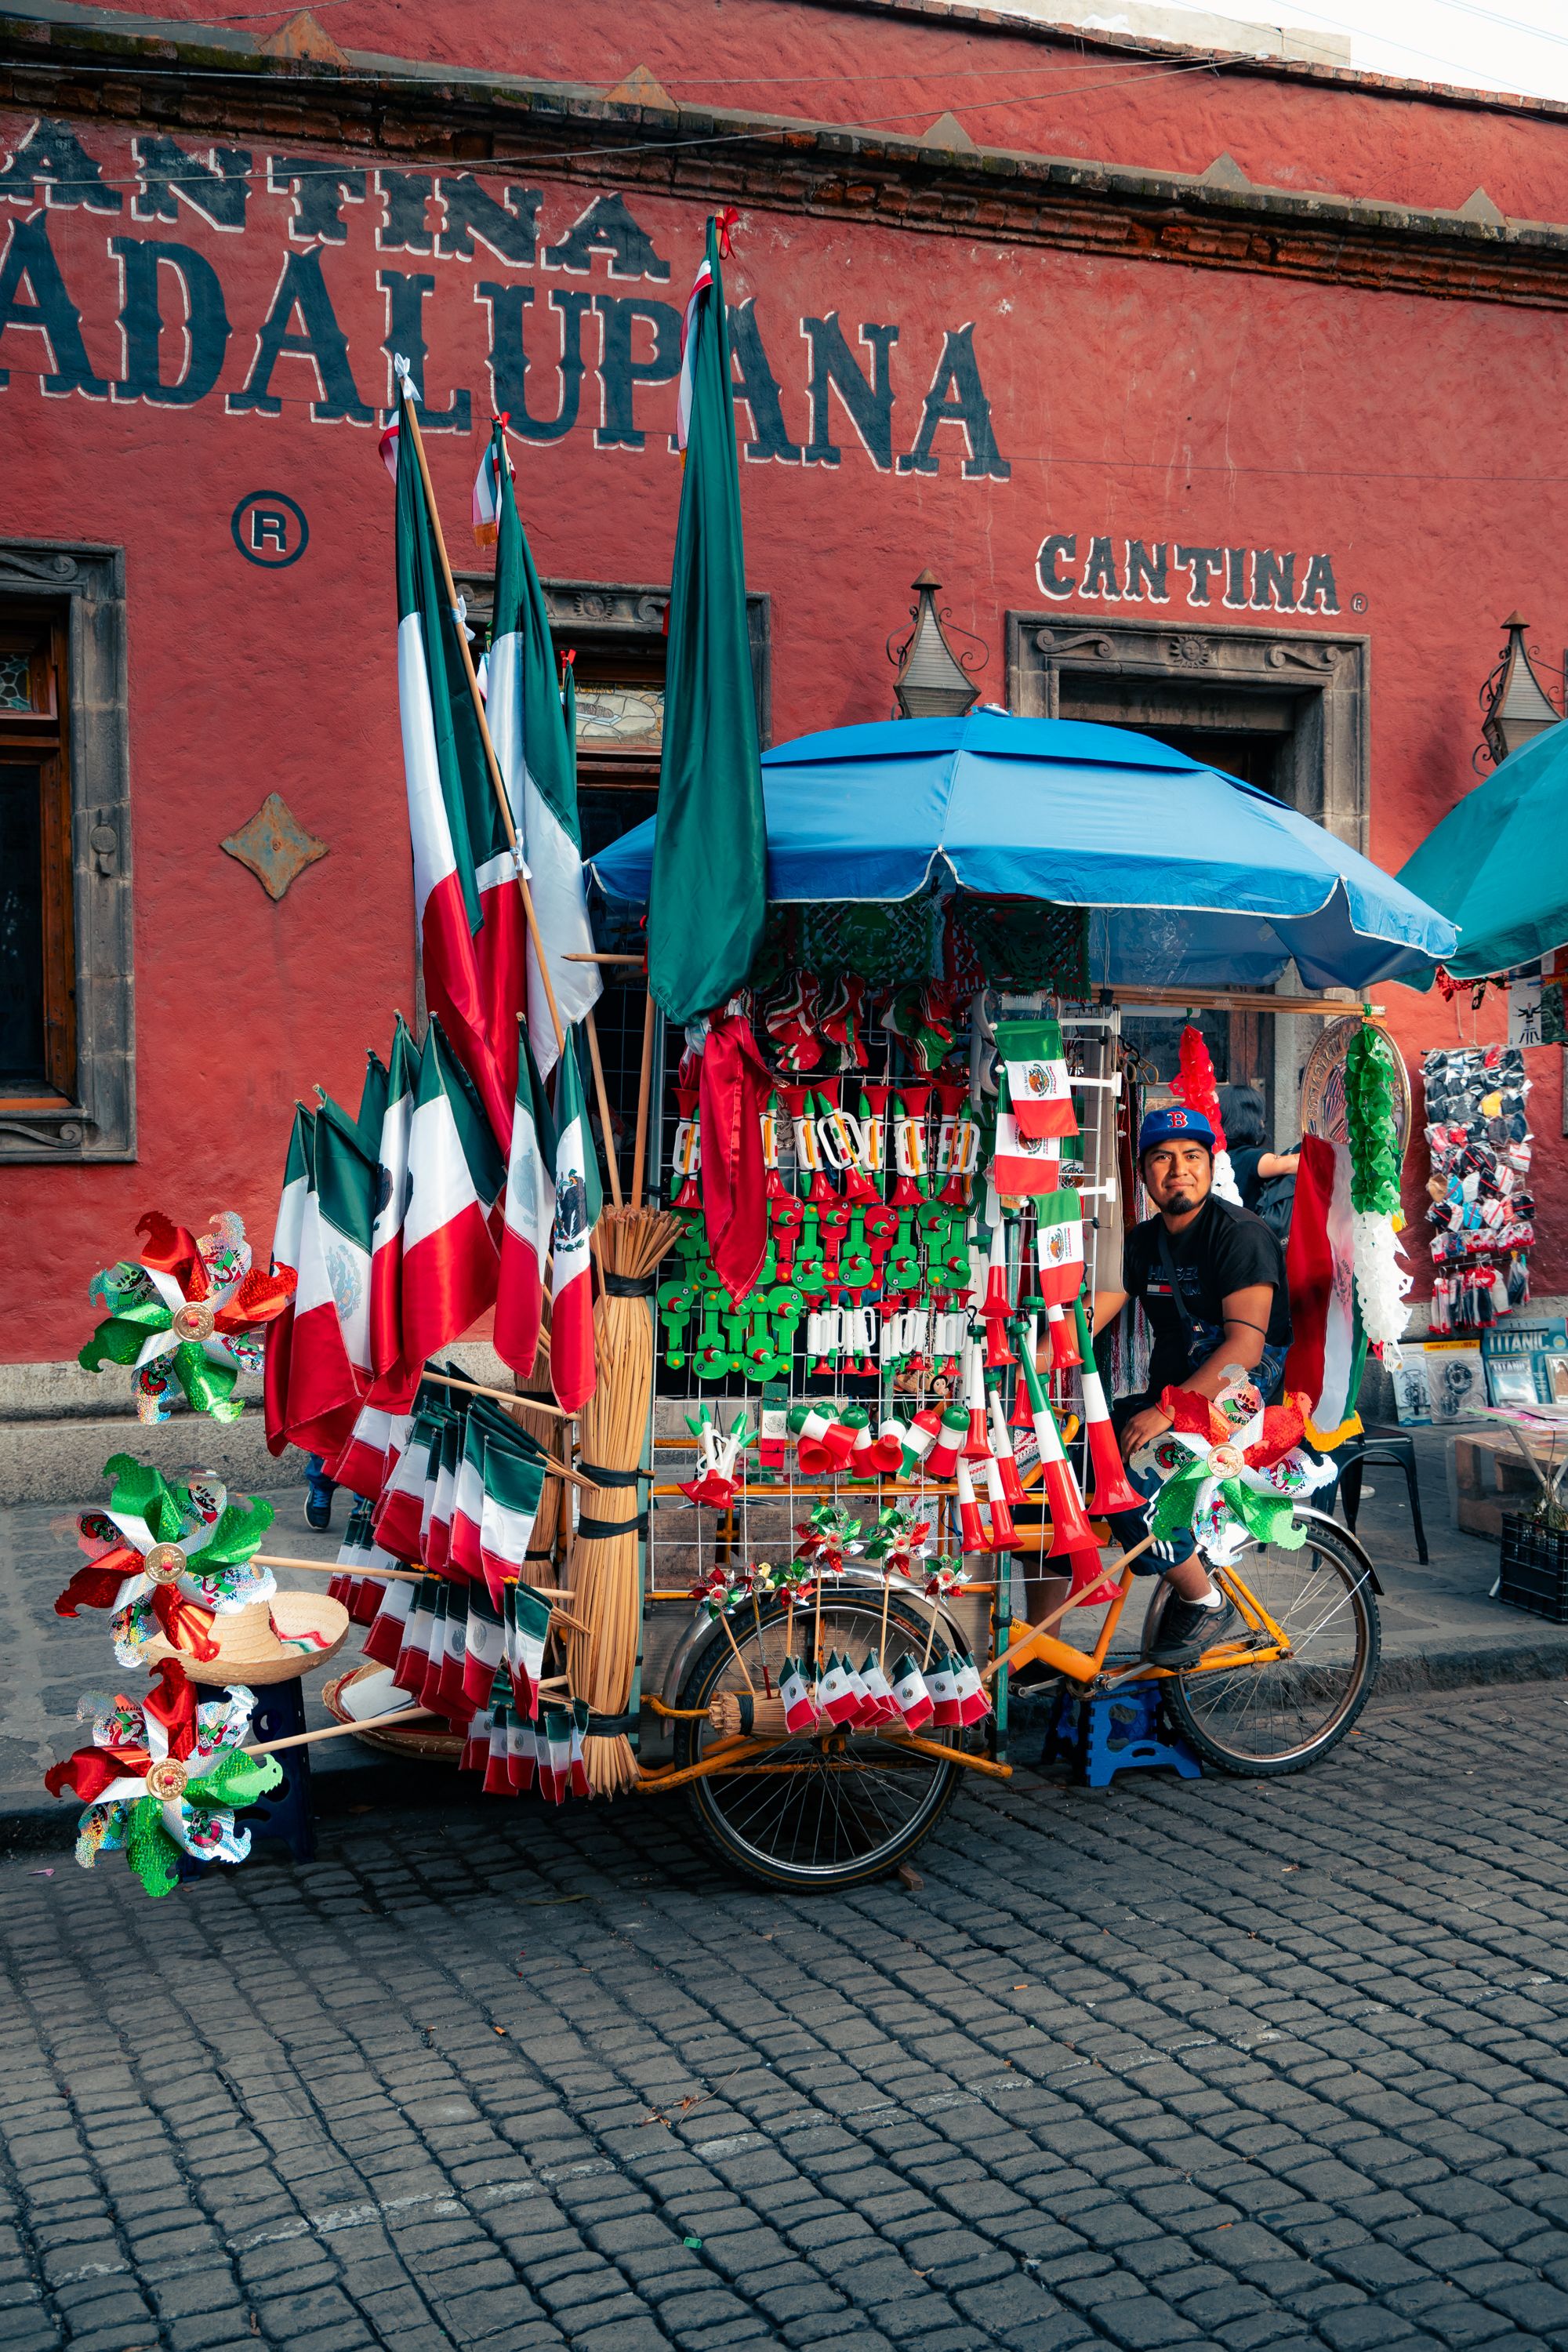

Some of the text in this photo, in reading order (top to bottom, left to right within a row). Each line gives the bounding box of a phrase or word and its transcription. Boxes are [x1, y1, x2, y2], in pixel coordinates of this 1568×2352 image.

[1035, 534, 1341, 615] CANTINA
[1167, 1111, 1189, 1127] B
[1488, 1331, 1550, 1352] TITANIC
